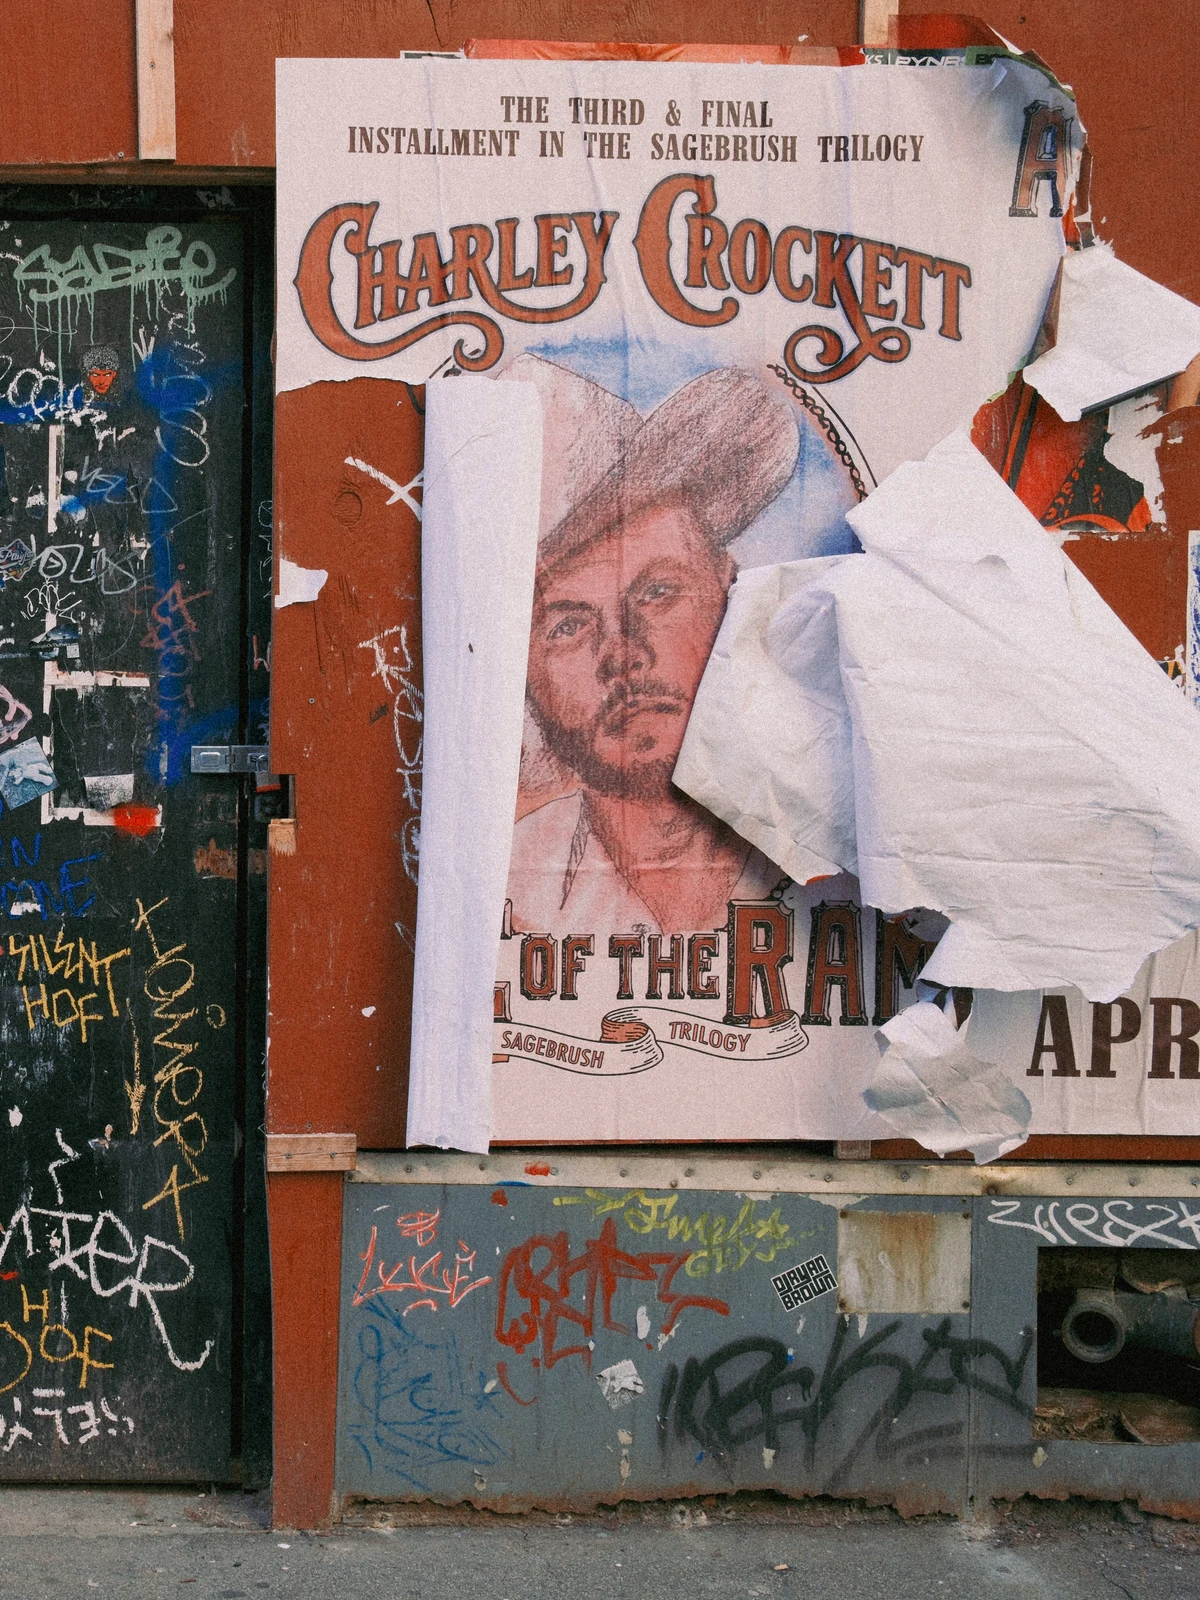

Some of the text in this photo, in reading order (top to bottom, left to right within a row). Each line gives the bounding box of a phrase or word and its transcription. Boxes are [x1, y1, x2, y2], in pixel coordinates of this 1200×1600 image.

[500, 96, 773, 128] THE THIRD & FINAL
[348, 126, 924, 163] INSTALLMENT IN THE SAGEBRUSH TRILOGY
[292, 172, 972, 385] CHARLEY CROCKETT
[519, 933, 595, 1001] OF
[608, 932, 721, 1001] THE
[501, 1020, 752, 1070] SAGEBRUSH TRILOGY
[780, 1272, 838, 1311] BROWN
